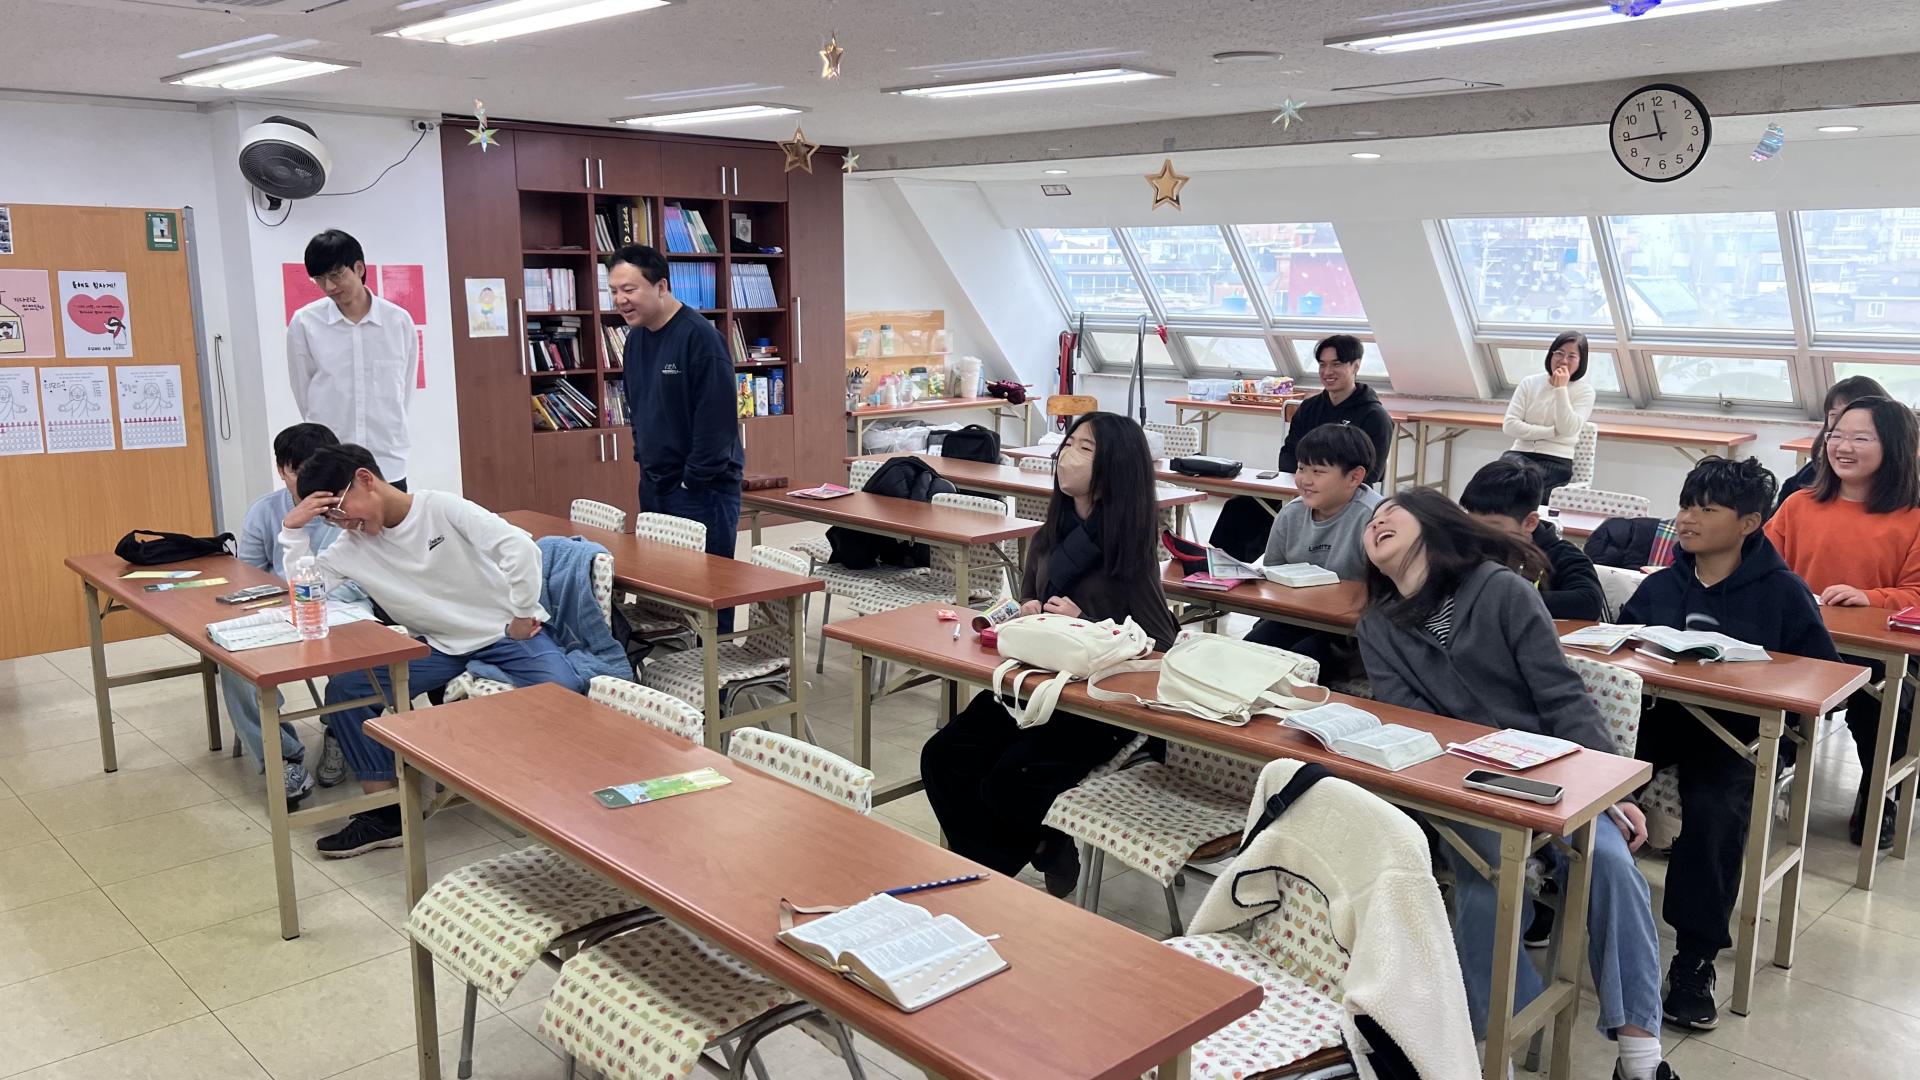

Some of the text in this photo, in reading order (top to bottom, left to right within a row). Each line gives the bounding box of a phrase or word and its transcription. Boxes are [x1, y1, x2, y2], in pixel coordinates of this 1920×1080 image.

[1651, 96, 1662, 106] 12
[1672, 100, 1677, 109] 1
[1636, 102, 1645, 112] 11
[1684, 109, 1692, 120] 2
[1625, 115, 1637, 125] 10
[1623, 132, 1630, 140] 9
[1691, 126, 1699, 136] 3
[1630, 148, 1638, 157] 8
[1687, 143, 1694, 152] 4
[1643, 157, 1650, 167] 7
[1676, 154, 1683, 164] 5
[1659, 160, 1667, 169] 6
